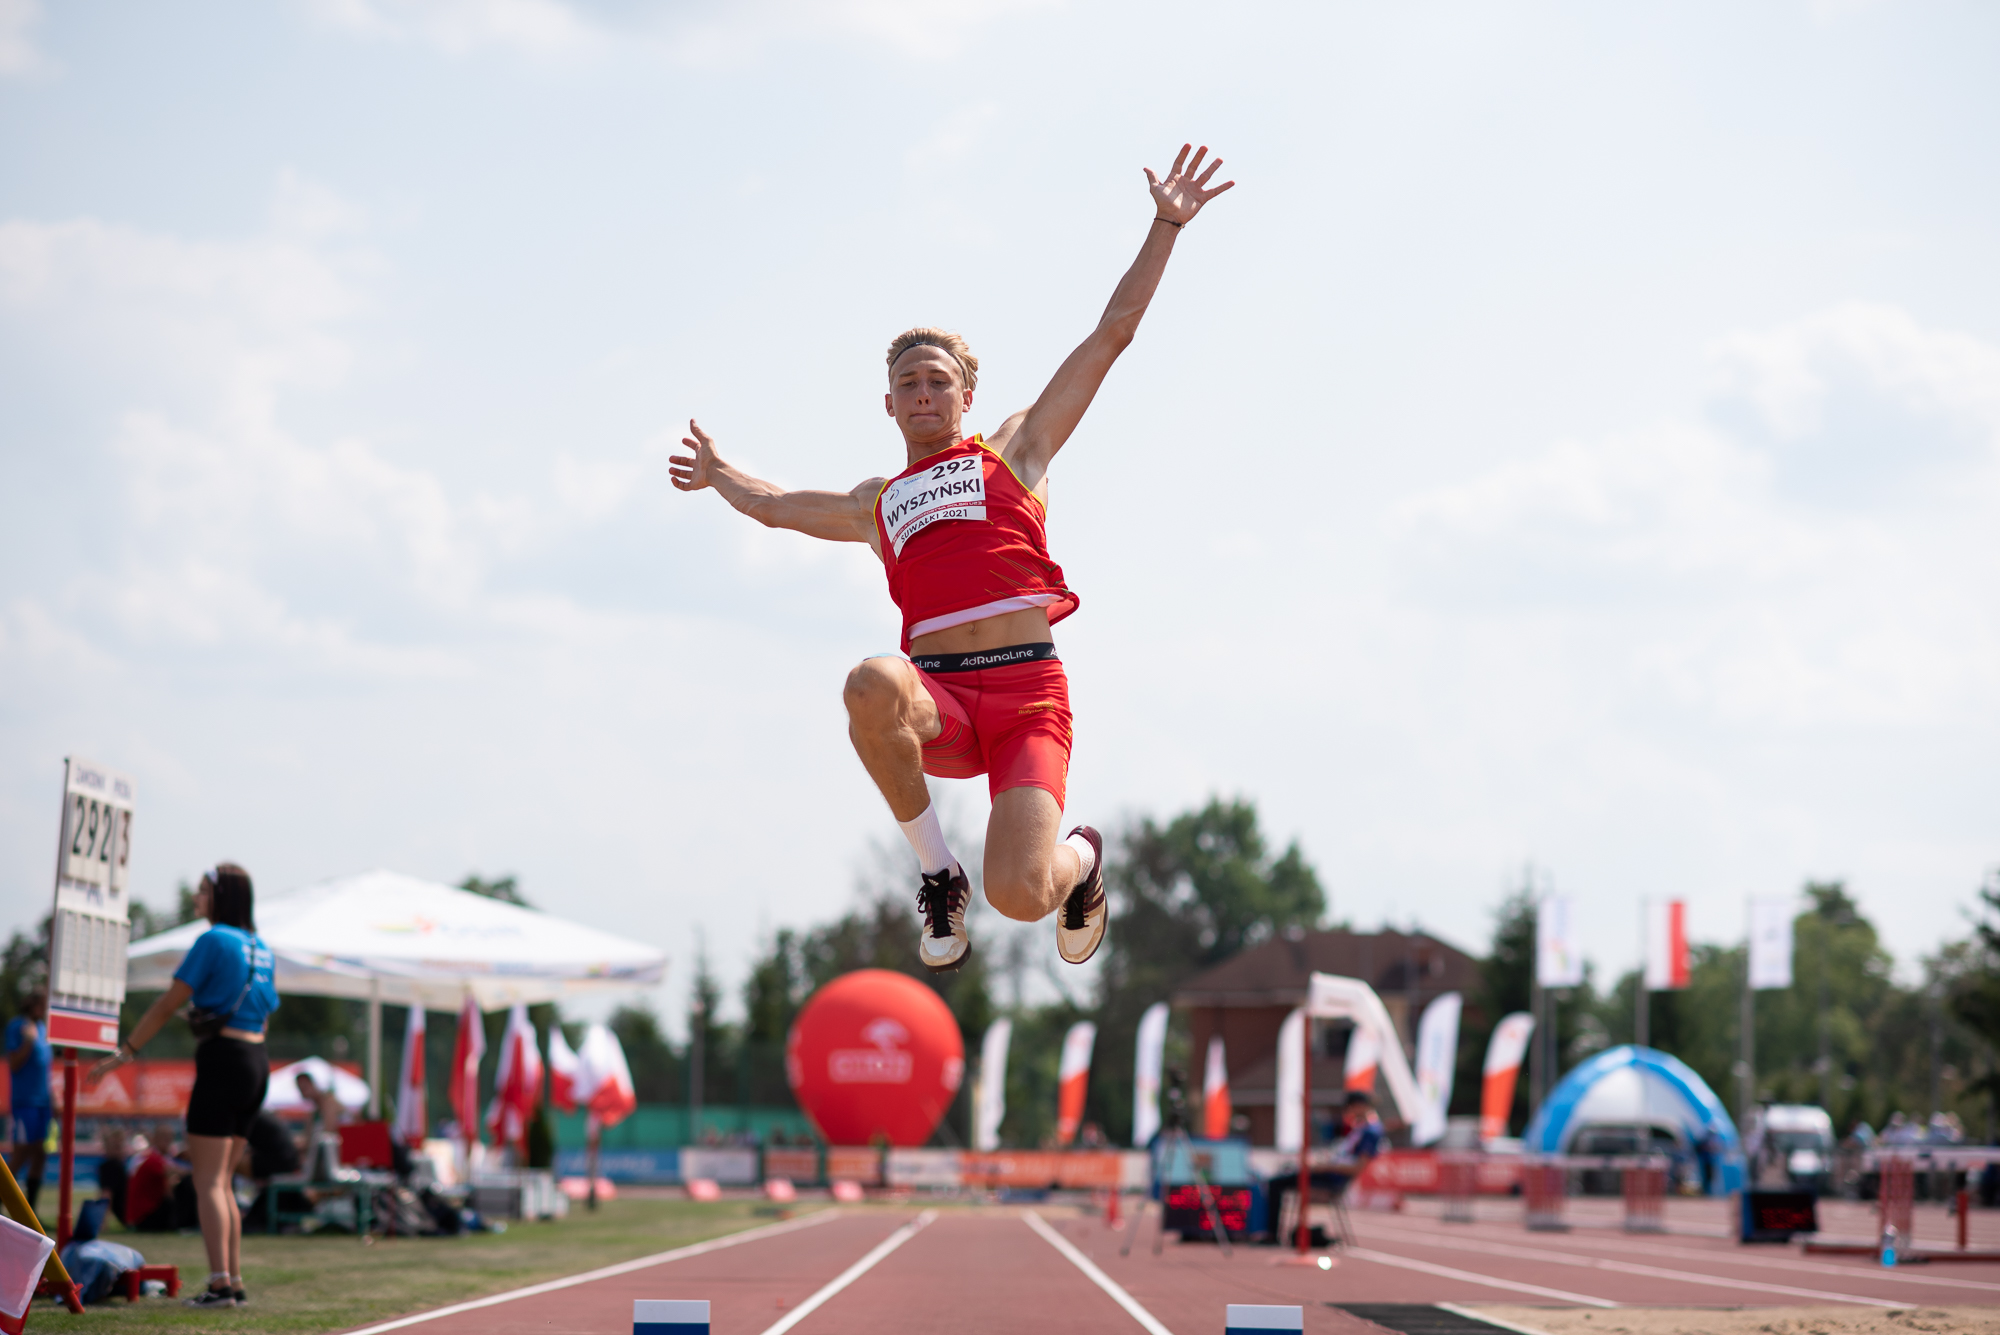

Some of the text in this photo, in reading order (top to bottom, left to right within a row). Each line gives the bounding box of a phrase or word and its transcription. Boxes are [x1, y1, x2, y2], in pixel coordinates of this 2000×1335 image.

[931, 459, 976, 481] 292
[886, 478, 981, 528] WYSZYŃSKI
[900, 513, 940, 543] SUWAŁKI
[942, 509, 968, 518] 2021
[960, 649, 1034, 667] AdRunaLine
[72, 795, 132, 867] 292 3
